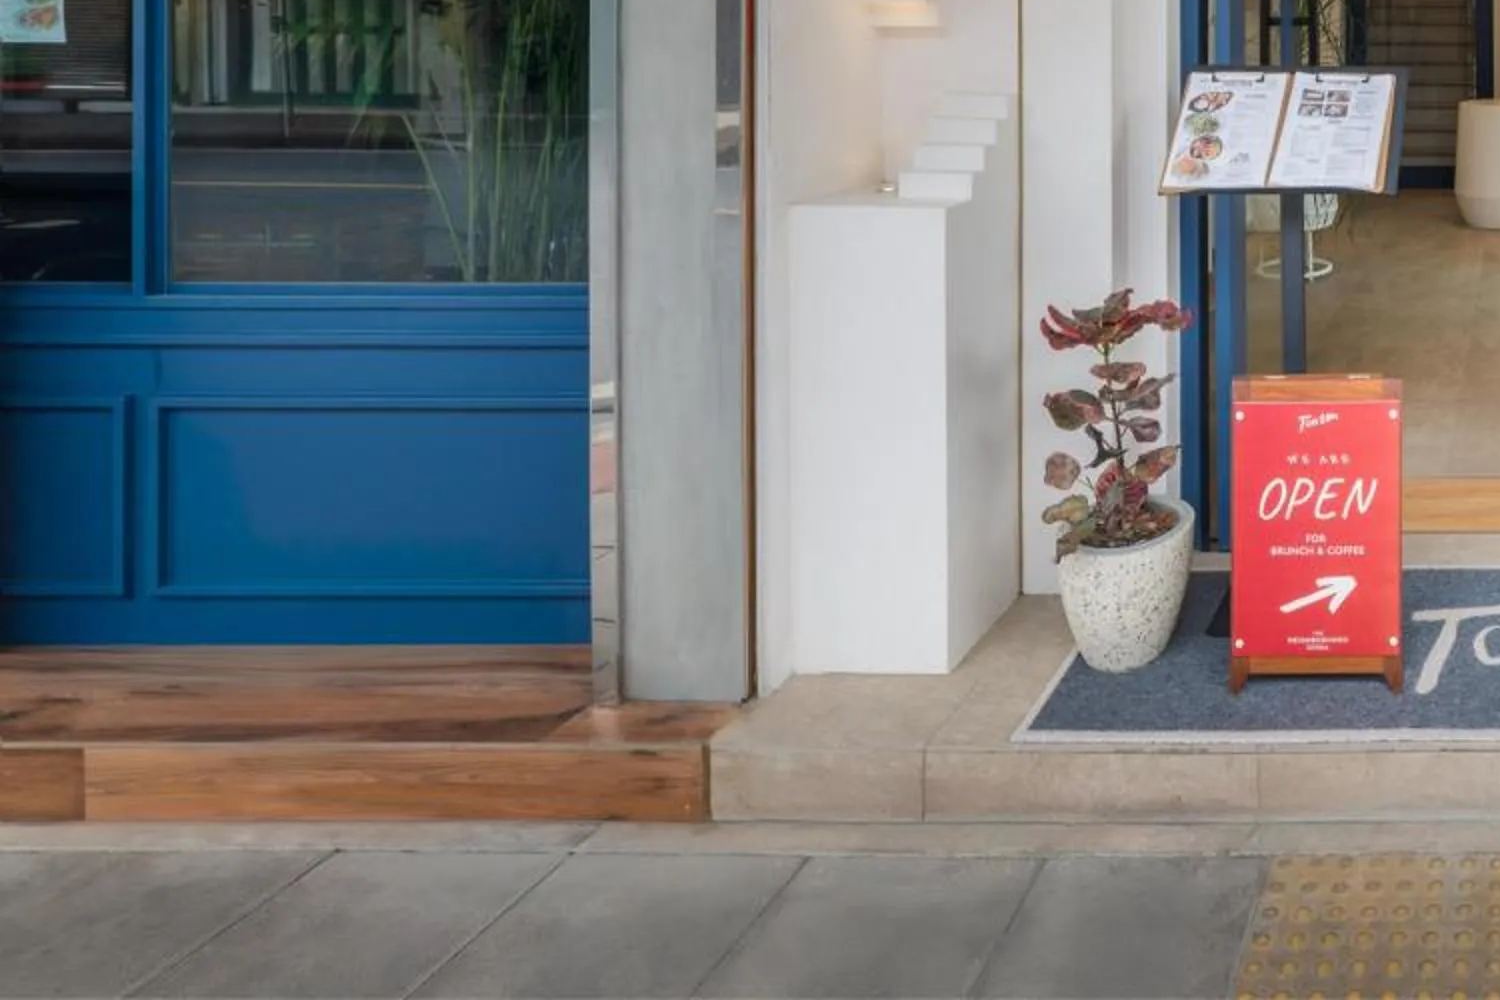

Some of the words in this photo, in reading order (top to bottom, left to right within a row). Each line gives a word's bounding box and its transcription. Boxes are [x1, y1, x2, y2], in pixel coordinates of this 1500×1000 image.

[1287, 454, 1310, 465] WE
[1319, 454, 1351, 465] ARE
[1258, 477, 1378, 521] OPEN
[1305, 532, 1327, 544] FOR
[1270, 545, 1315, 557] BRUNCH
[1327, 544, 1366, 556] COFFEE
